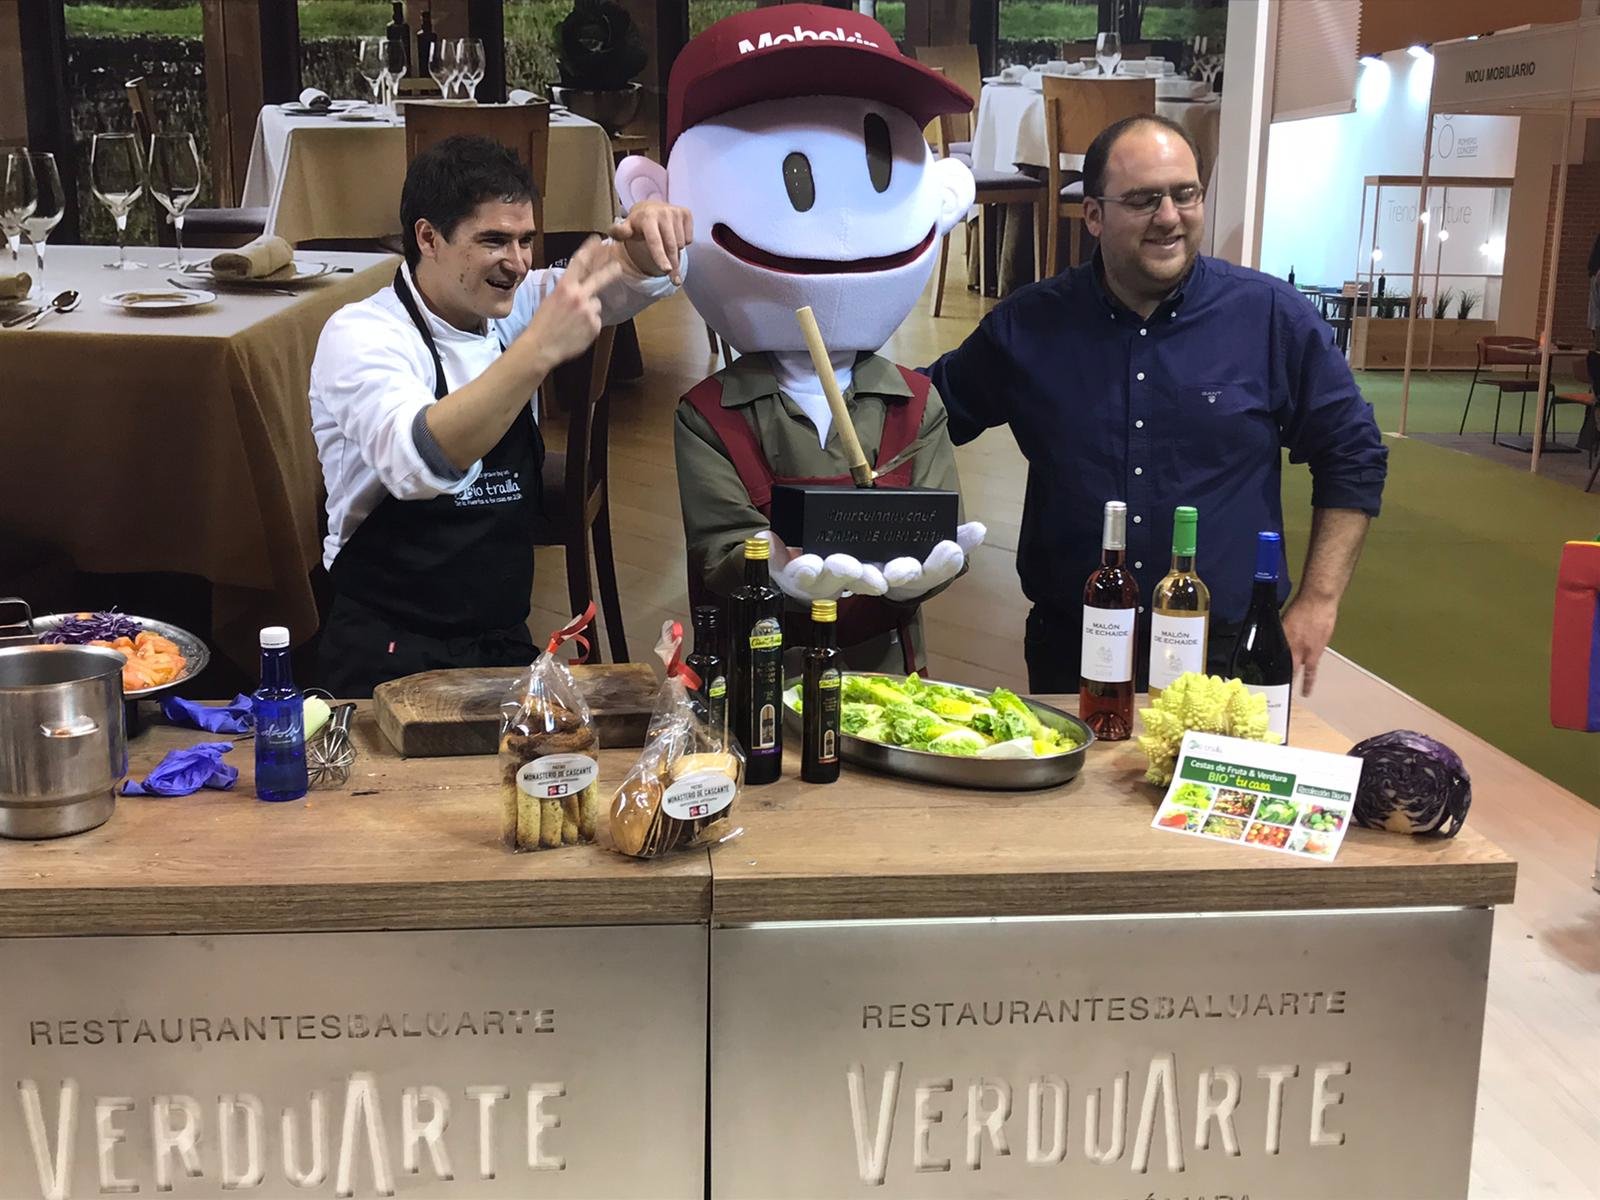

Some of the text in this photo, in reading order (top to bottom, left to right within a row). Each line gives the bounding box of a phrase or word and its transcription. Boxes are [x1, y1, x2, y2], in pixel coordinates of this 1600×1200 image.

[1465, 61, 1536, 84] INOU MOBILIARIO
[524, 766, 593, 781] MONASTERIO DE CASCANTE
[1190, 759, 1289, 784] Cestas de Fruta & Verdura
[1208, 771, 1229, 784] BIO
[1236, 775, 1248, 787] tu
[1248, 780, 1272, 792] casa
[667, 791, 696, 804] MONASTERIO
[696, 789, 704, 798] DE
[704, 784, 730, 797] CASCANTE
